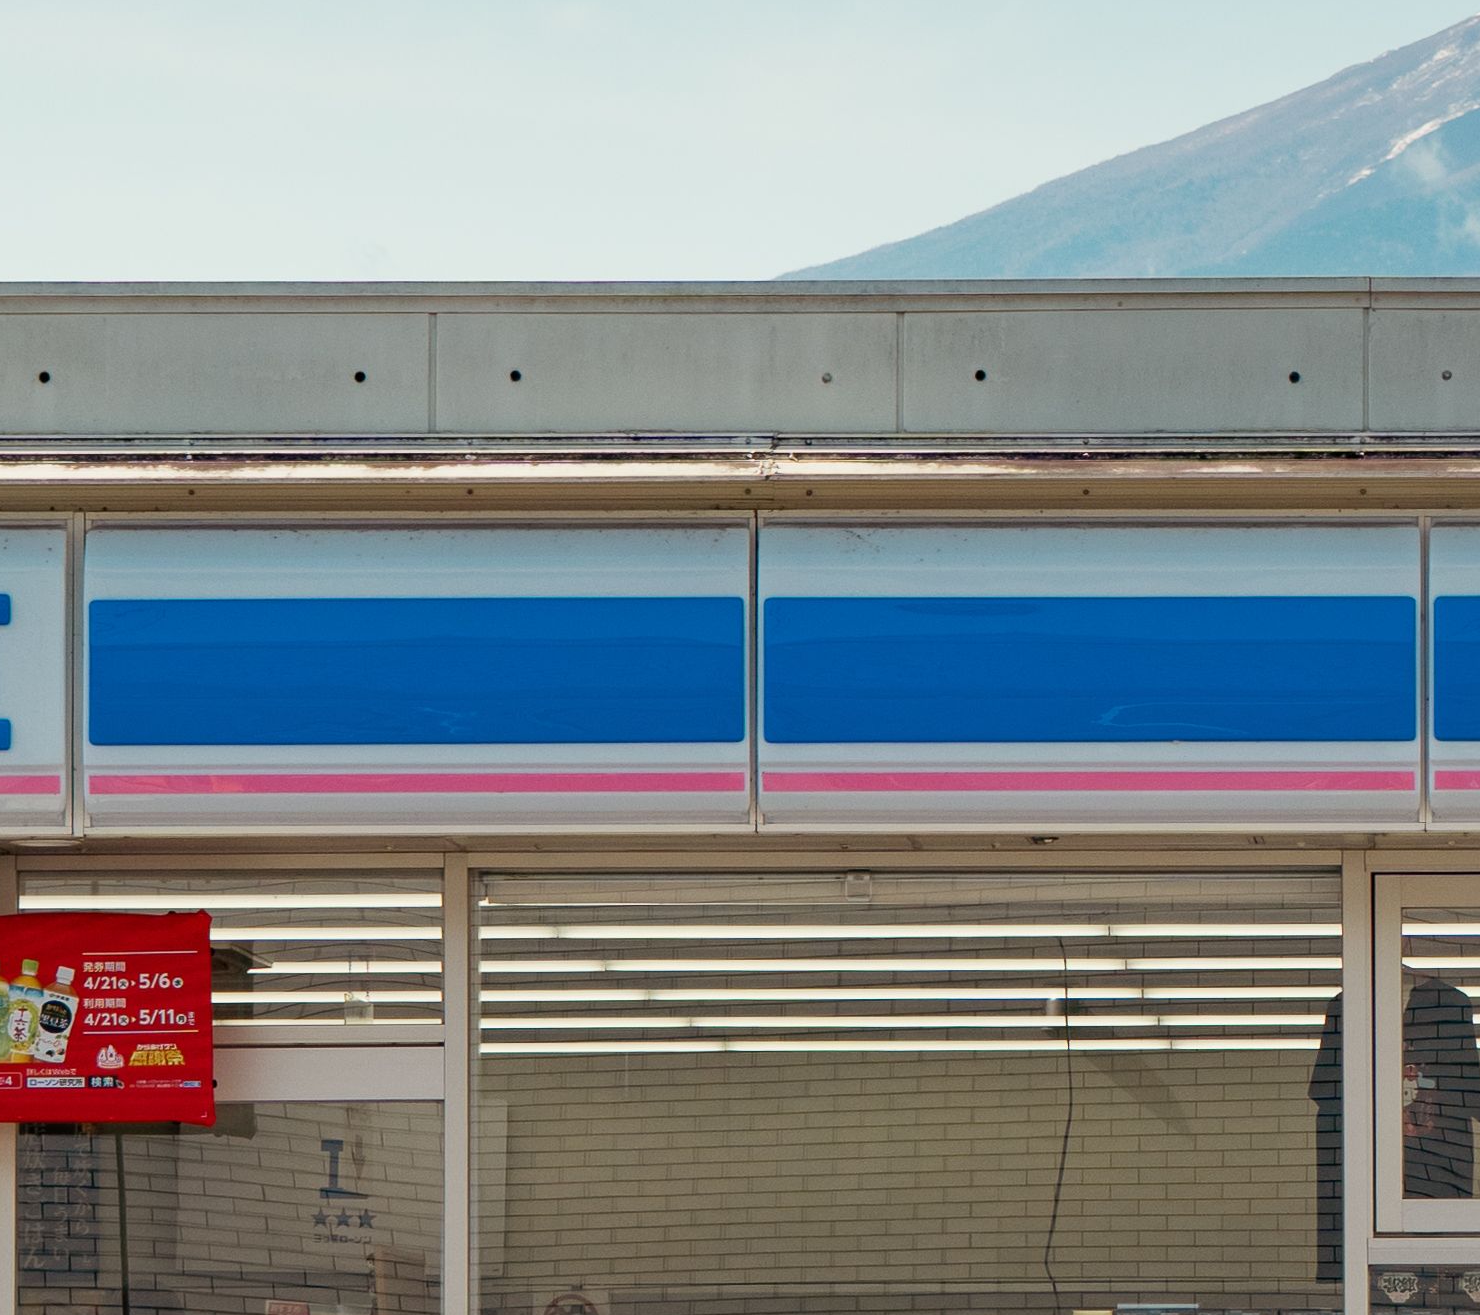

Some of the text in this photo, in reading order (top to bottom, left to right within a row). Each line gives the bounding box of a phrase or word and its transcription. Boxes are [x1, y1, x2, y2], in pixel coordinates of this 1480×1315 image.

[83, 962, 126, 973] 発券期間
[83, 998, 127, 1009] 利用期間
[29, 1078, 84, 1087] ローソン研究所
